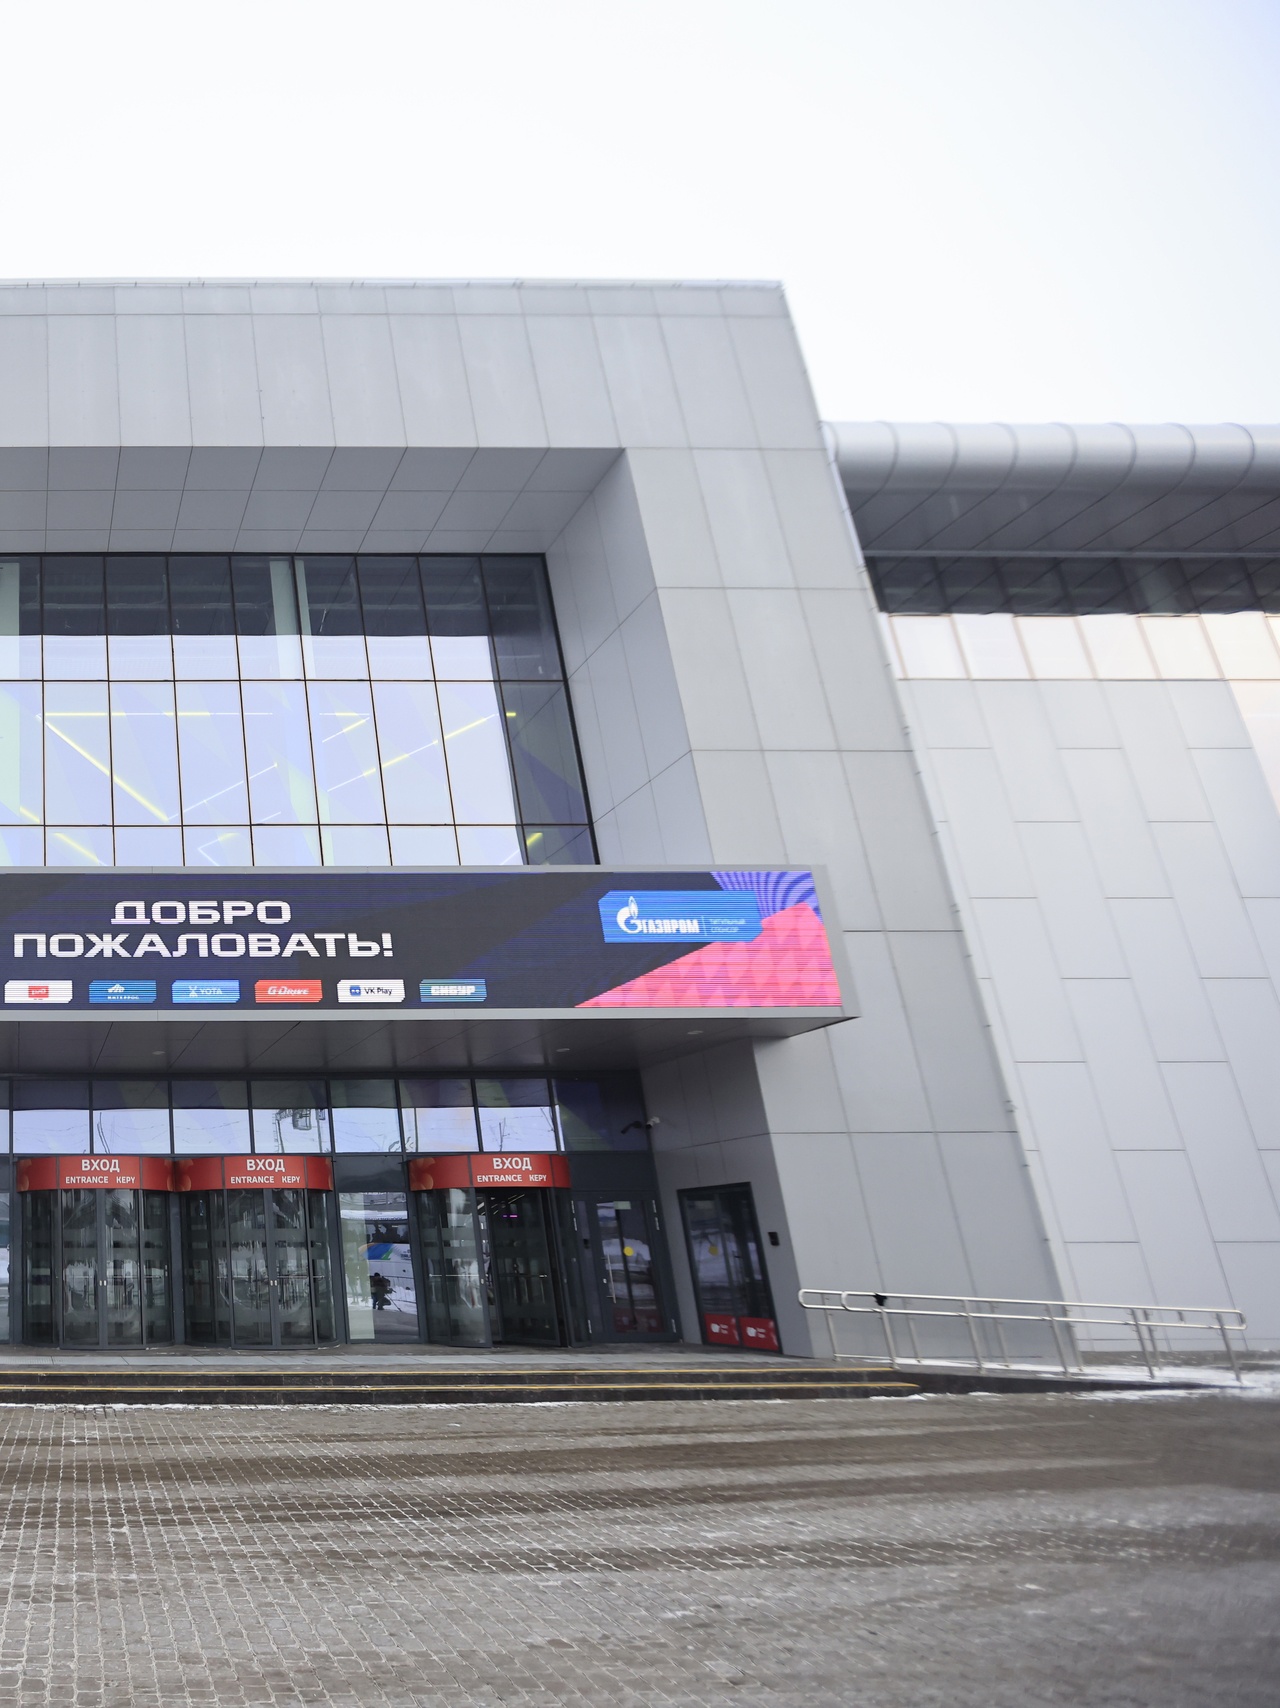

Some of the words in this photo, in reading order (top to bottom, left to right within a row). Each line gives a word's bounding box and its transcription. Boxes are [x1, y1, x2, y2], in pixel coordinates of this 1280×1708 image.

[110, 900, 292, 925] ДОБРО
[640, 919, 700, 934] ГАЗПРОМ
[13, 932, 394, 958] ПОЖАЛОВАТЬ!
[364, 987, 375, 995] VK
[377, 987, 392, 996] Play
[81, 1159, 120, 1173] ВХОД
[246, 1159, 286, 1172] ВХОД
[492, 1157, 532, 1170] ВХОД
[65, 1176, 109, 1184] ENTRANCE
[230, 1176, 275, 1184] ENTRANCE
[477, 1174, 523, 1182] ENTRANCE
